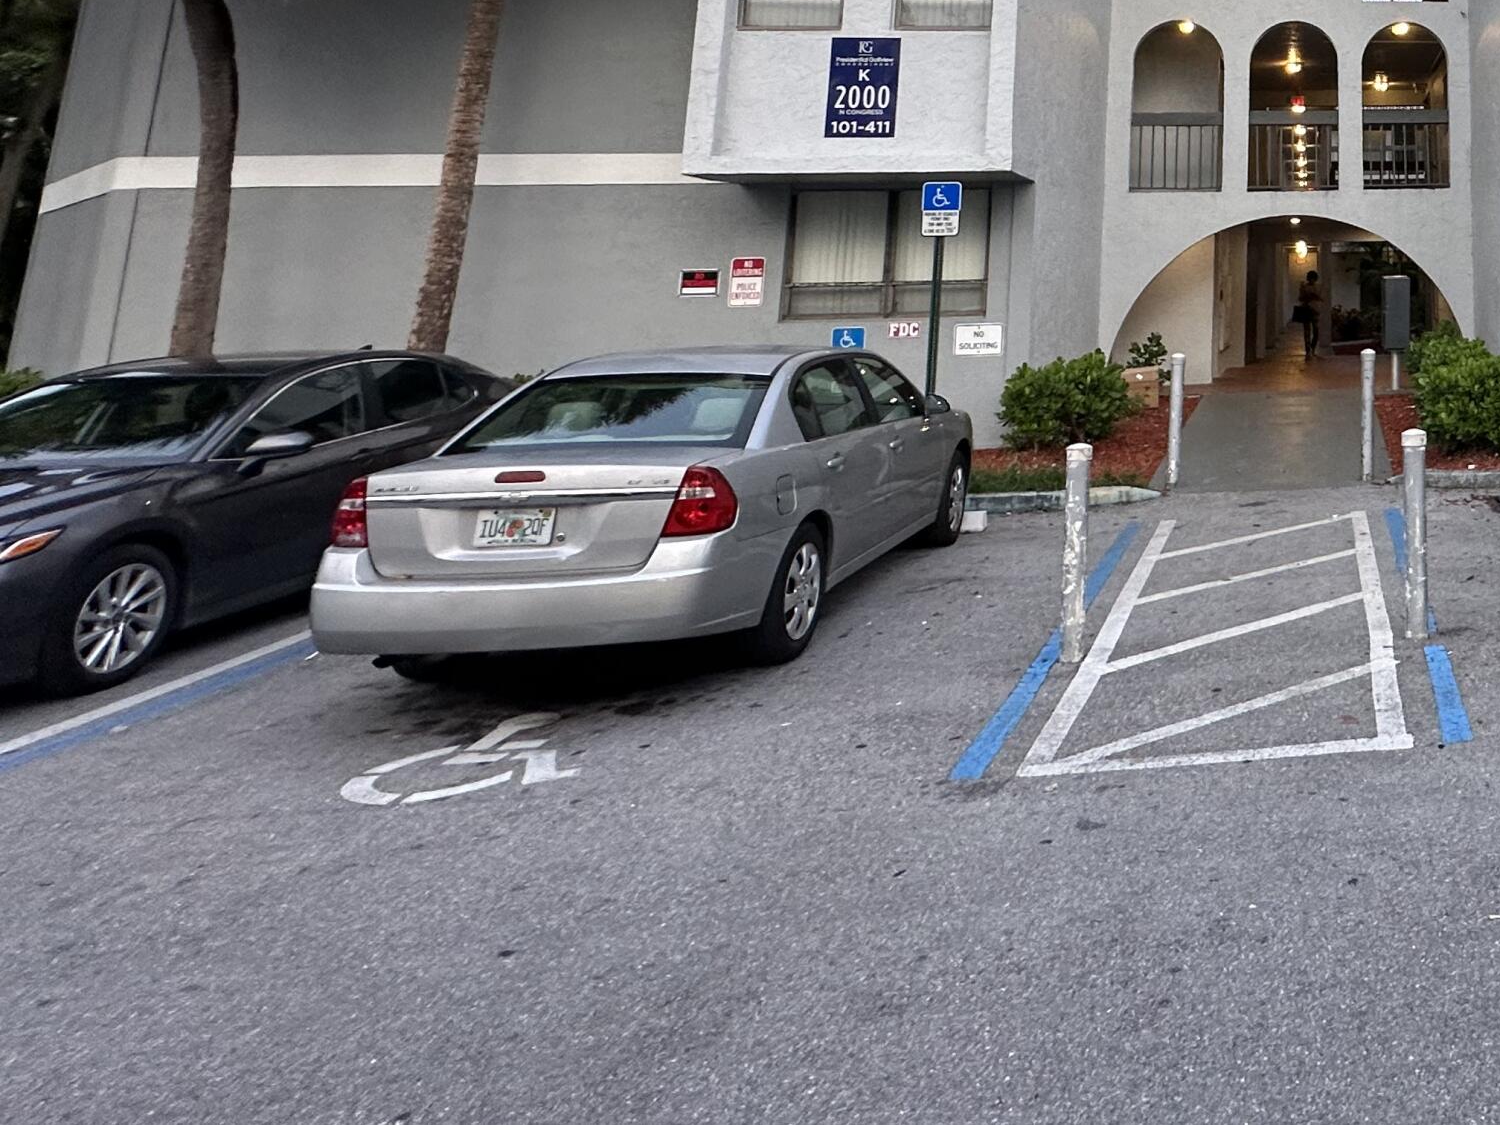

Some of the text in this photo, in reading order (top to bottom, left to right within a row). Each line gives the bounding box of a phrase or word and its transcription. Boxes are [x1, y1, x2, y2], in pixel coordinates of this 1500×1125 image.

[858, 69, 871, 82] K
[834, 85, 890, 109] 2000
[831, 121, 891, 134] 101-411
[889, 322, 920, 337] FDC
[958, 342, 998, 350] SOLICITING
